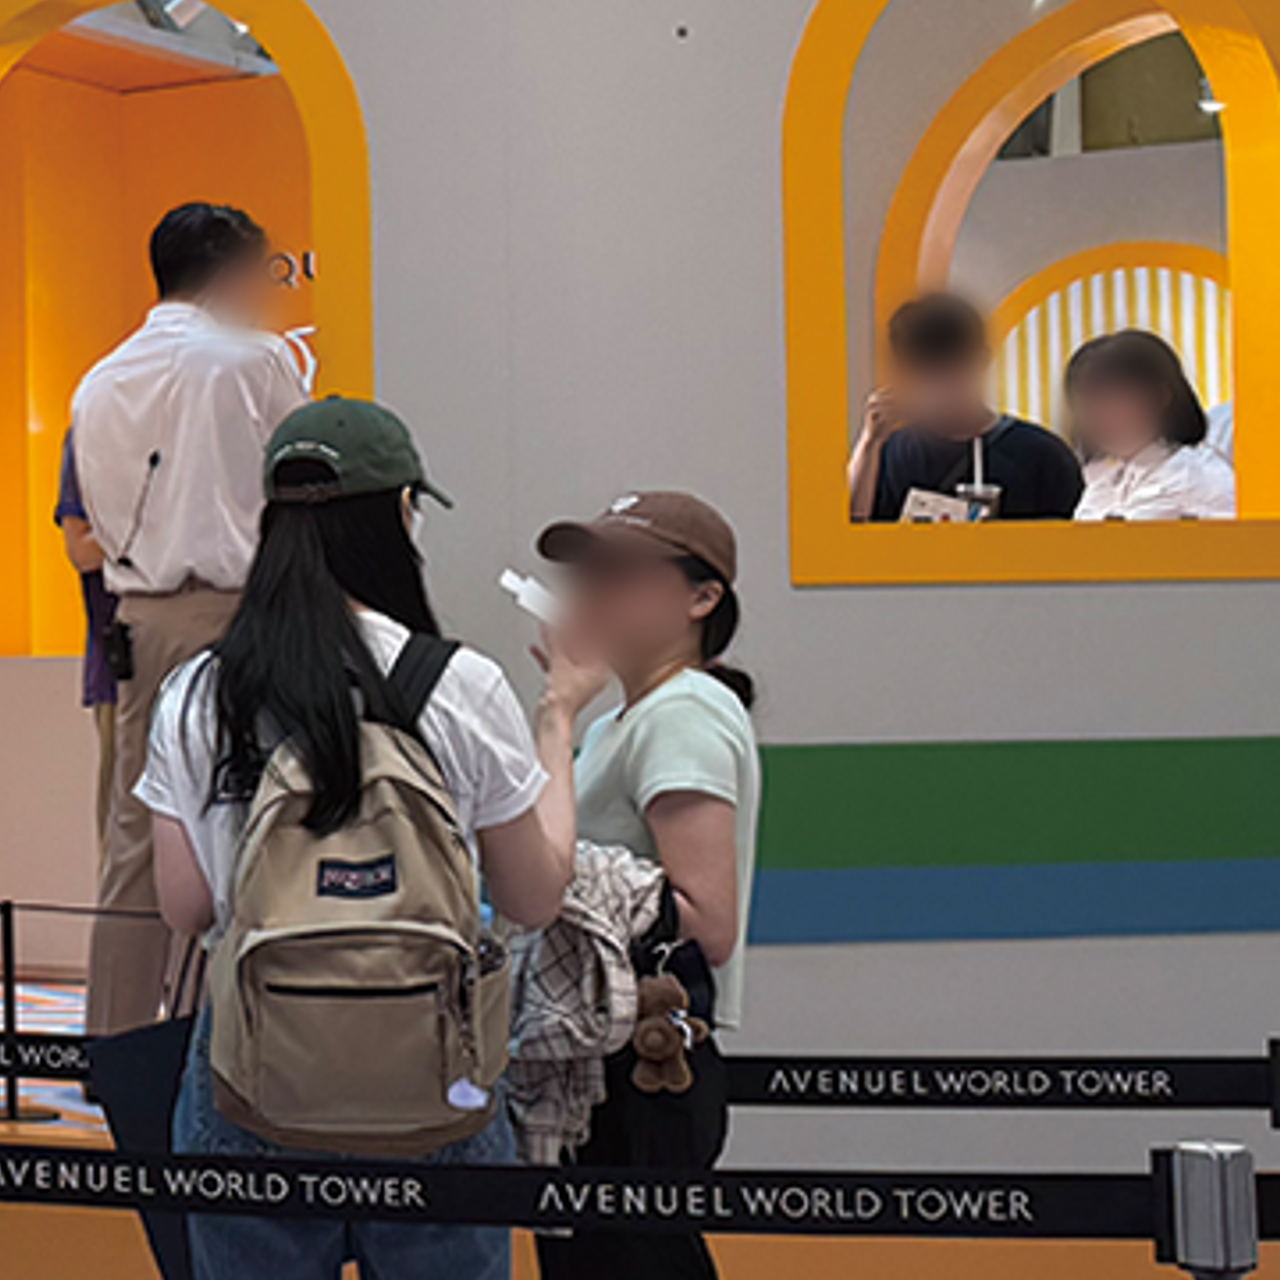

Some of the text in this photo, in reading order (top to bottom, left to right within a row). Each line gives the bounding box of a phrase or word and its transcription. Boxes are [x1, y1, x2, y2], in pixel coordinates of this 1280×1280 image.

[18, 1044, 90, 1068] WOR
[769, 1069, 1173, 1096] AVENUEL WORLD TOWER
[163, 1168, 289, 1202] WORLD
[298, 1173, 427, 1207] TOWER
[539, 1182, 1033, 1221] AVENUEL WORLD TOWER
